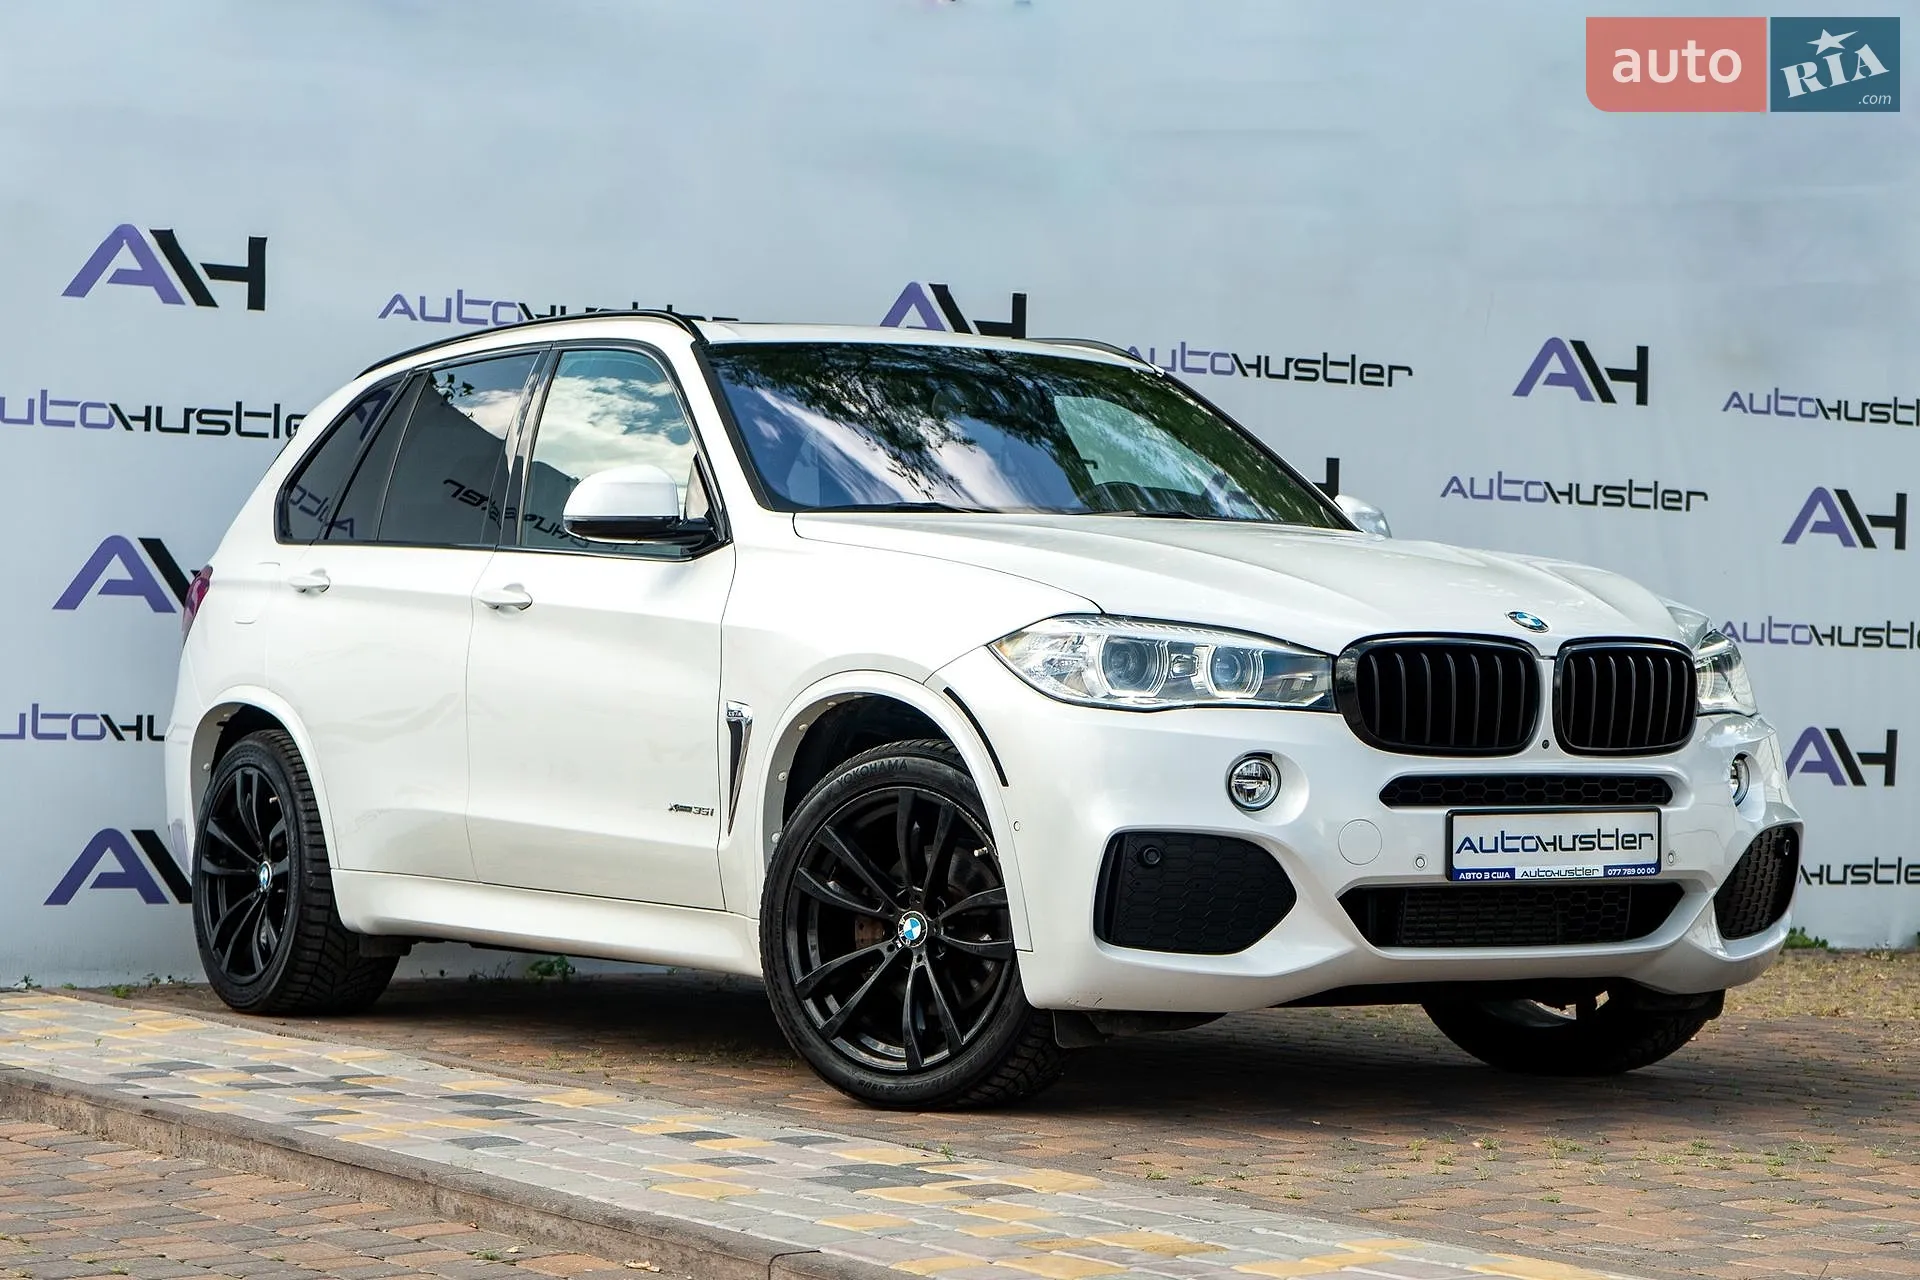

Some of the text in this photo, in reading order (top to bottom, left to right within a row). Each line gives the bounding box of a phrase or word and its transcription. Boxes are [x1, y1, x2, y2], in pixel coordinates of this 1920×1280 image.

[62, 223, 268, 311] AH
[1512, 337, 1649, 406] AH
[1440, 471, 1708, 512] AutoHustler
[1781, 486, 1908, 550] AH
[1720, 615, 1920, 649] AutoHustl
[1785, 726, 1898, 786] AH
[1455, 828, 1654, 854] AutoHustler
